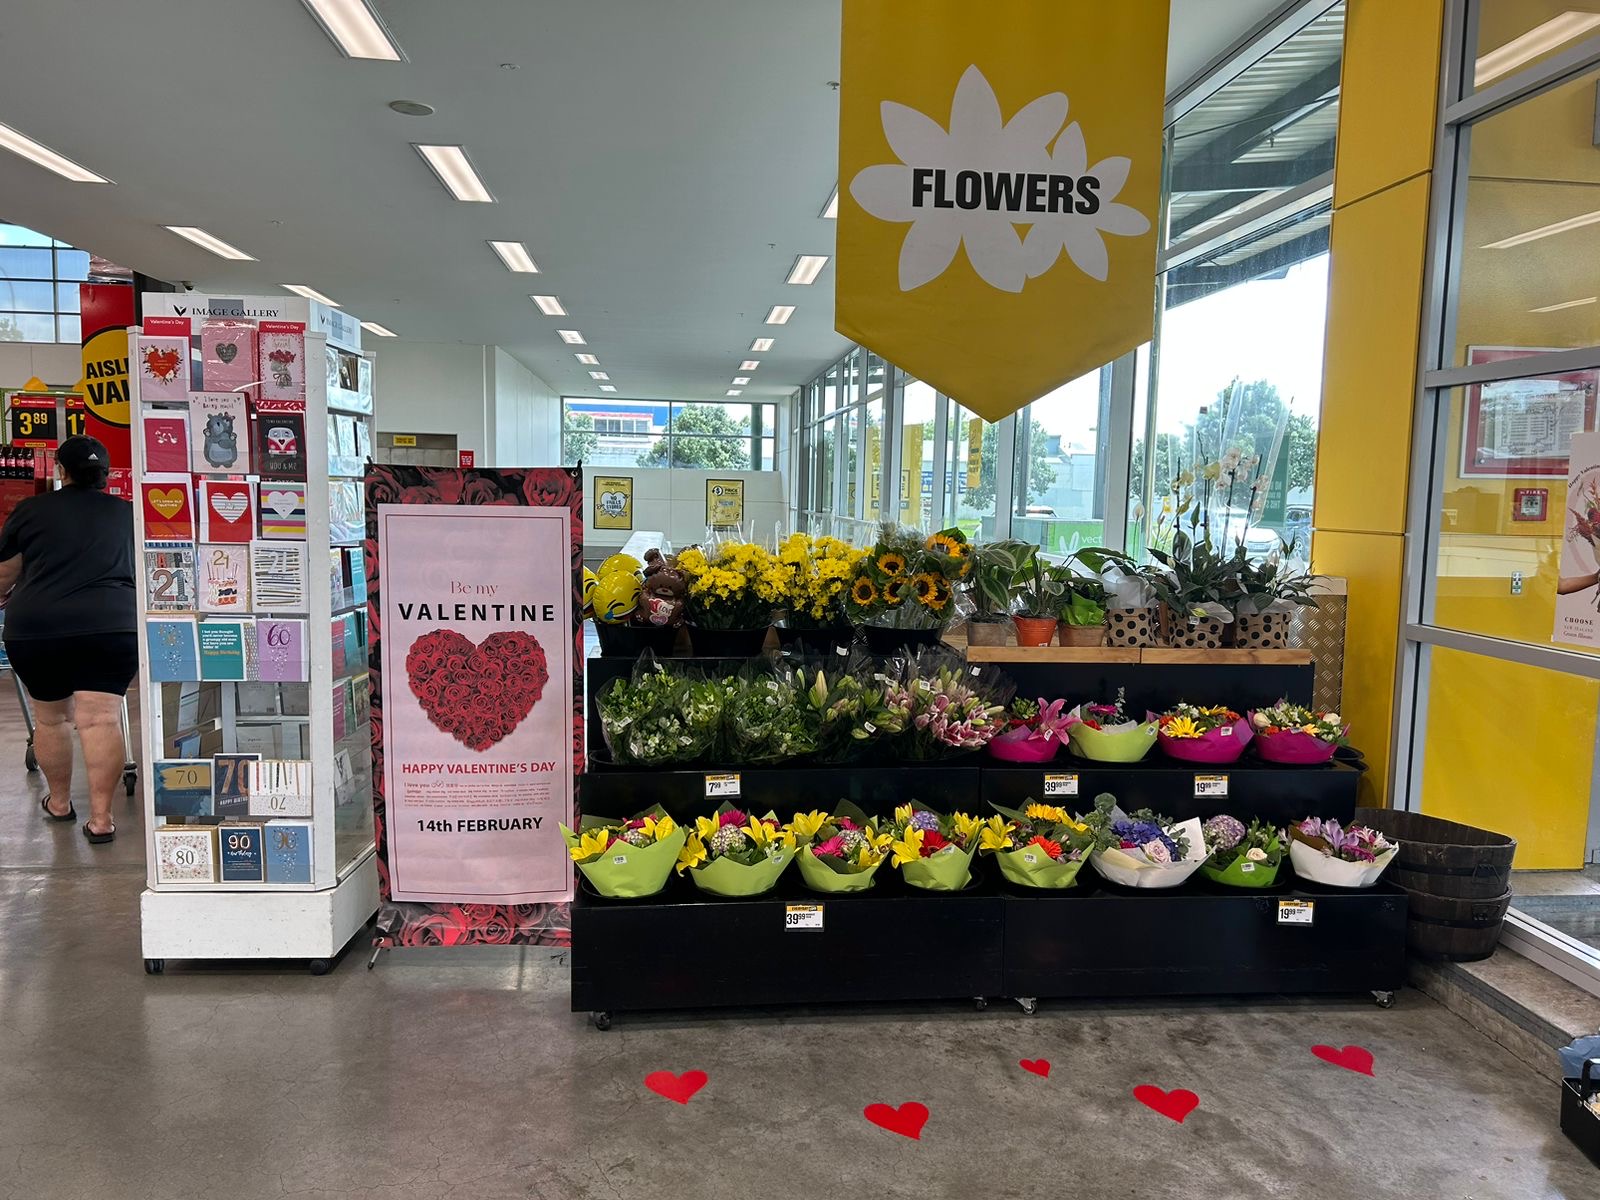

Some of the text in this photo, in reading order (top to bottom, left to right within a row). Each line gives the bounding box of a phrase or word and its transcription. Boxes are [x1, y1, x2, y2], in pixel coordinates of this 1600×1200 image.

[912, 168, 1100, 215] FLOWERS
[192, 308, 279, 318] IMAGE GALLERY
[214, 550, 229, 569] 21
[153, 569, 188, 602] 21
[450, 580, 499, 597] Be my
[398, 603, 555, 622] VALENTINE
[1564, 616, 1593, 625] CHOOSE
[267, 624, 290, 647] 60
[402, 761, 556, 774] HAPPY VALENTINE'S DAY
[175, 770, 198, 785] 70
[417, 817, 543, 832] 14th FEBRUARY
[228, 834, 250, 849] 90
[176, 850, 194, 865] 80
